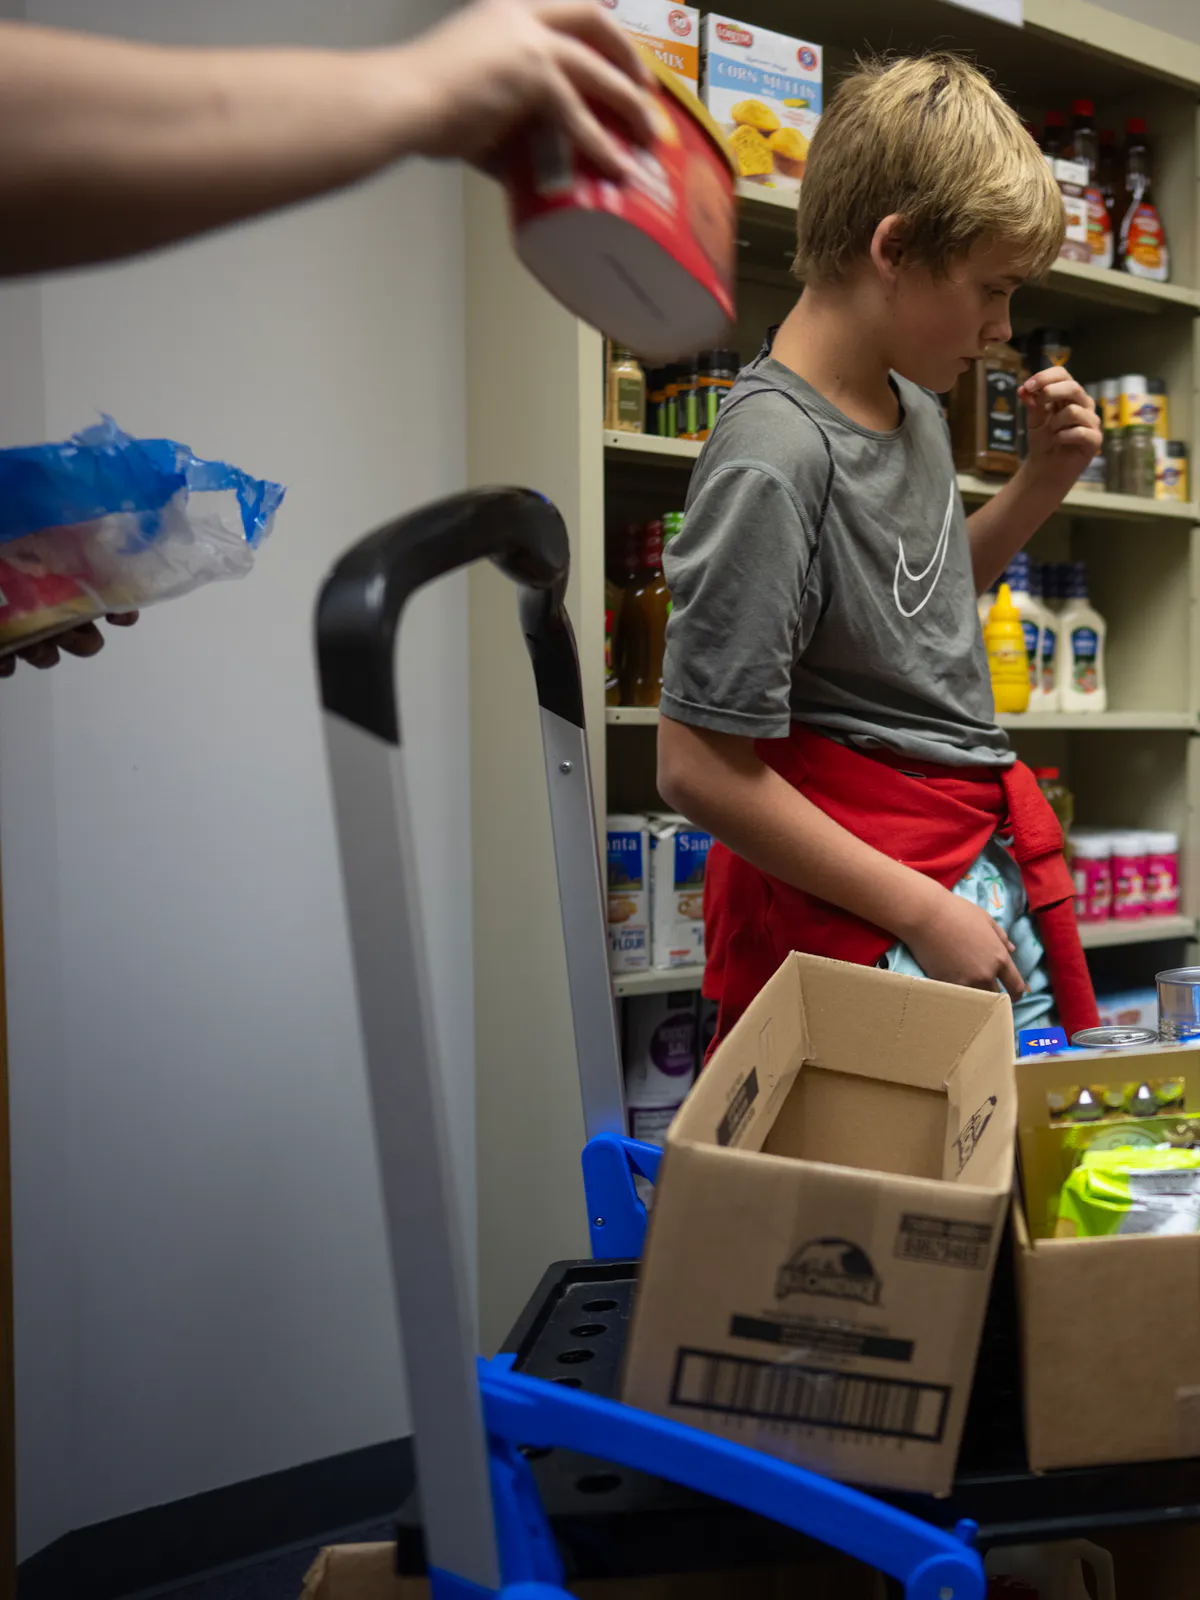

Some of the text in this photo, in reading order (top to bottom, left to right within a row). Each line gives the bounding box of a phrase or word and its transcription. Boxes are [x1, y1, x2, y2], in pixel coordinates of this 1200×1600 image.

[654, 50, 685, 71] MIX
[717, 62, 758, 84] CORN
[761, 73, 817, 99] MUFFIN
